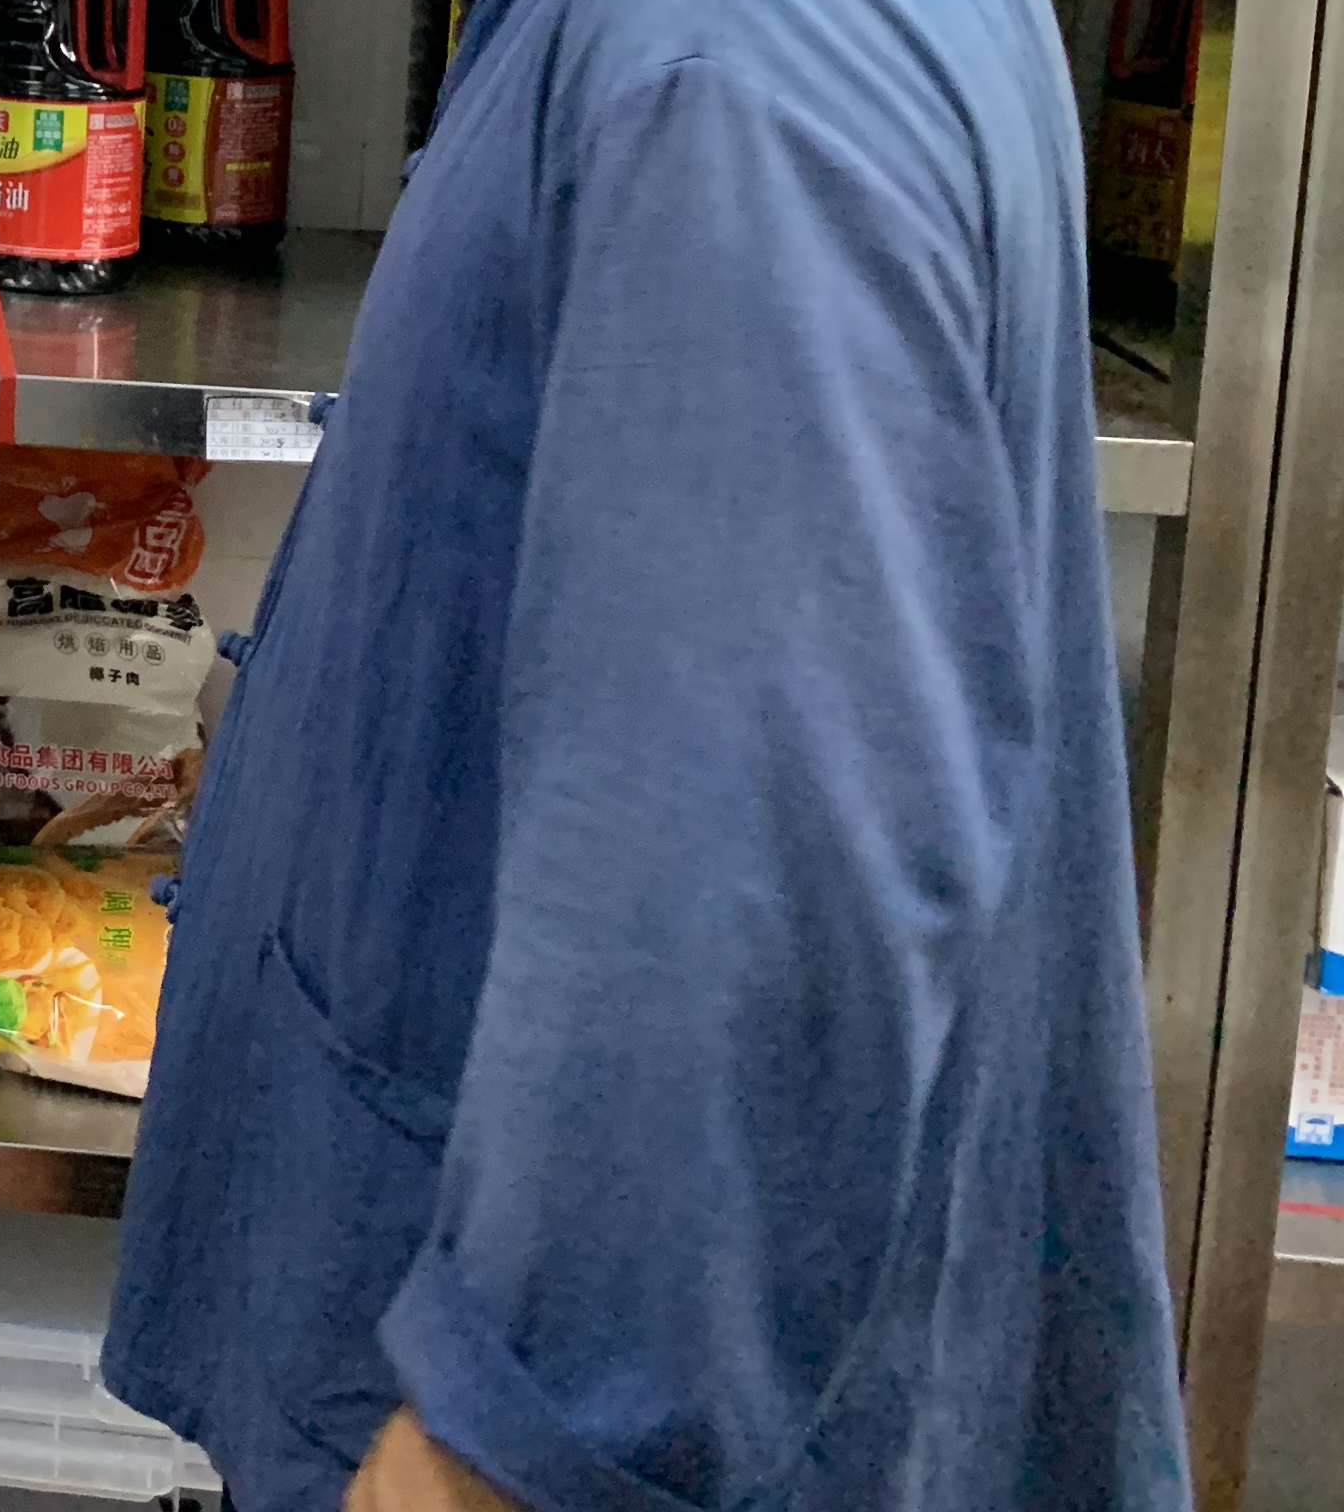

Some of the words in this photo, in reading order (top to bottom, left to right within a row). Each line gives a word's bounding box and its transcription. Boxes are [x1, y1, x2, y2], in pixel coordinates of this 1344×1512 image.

[55, 629, 166, 667] 烘焙用品
[5, 773, 59, 791] FOODS
[63, 777, 118, 795] GROUP
